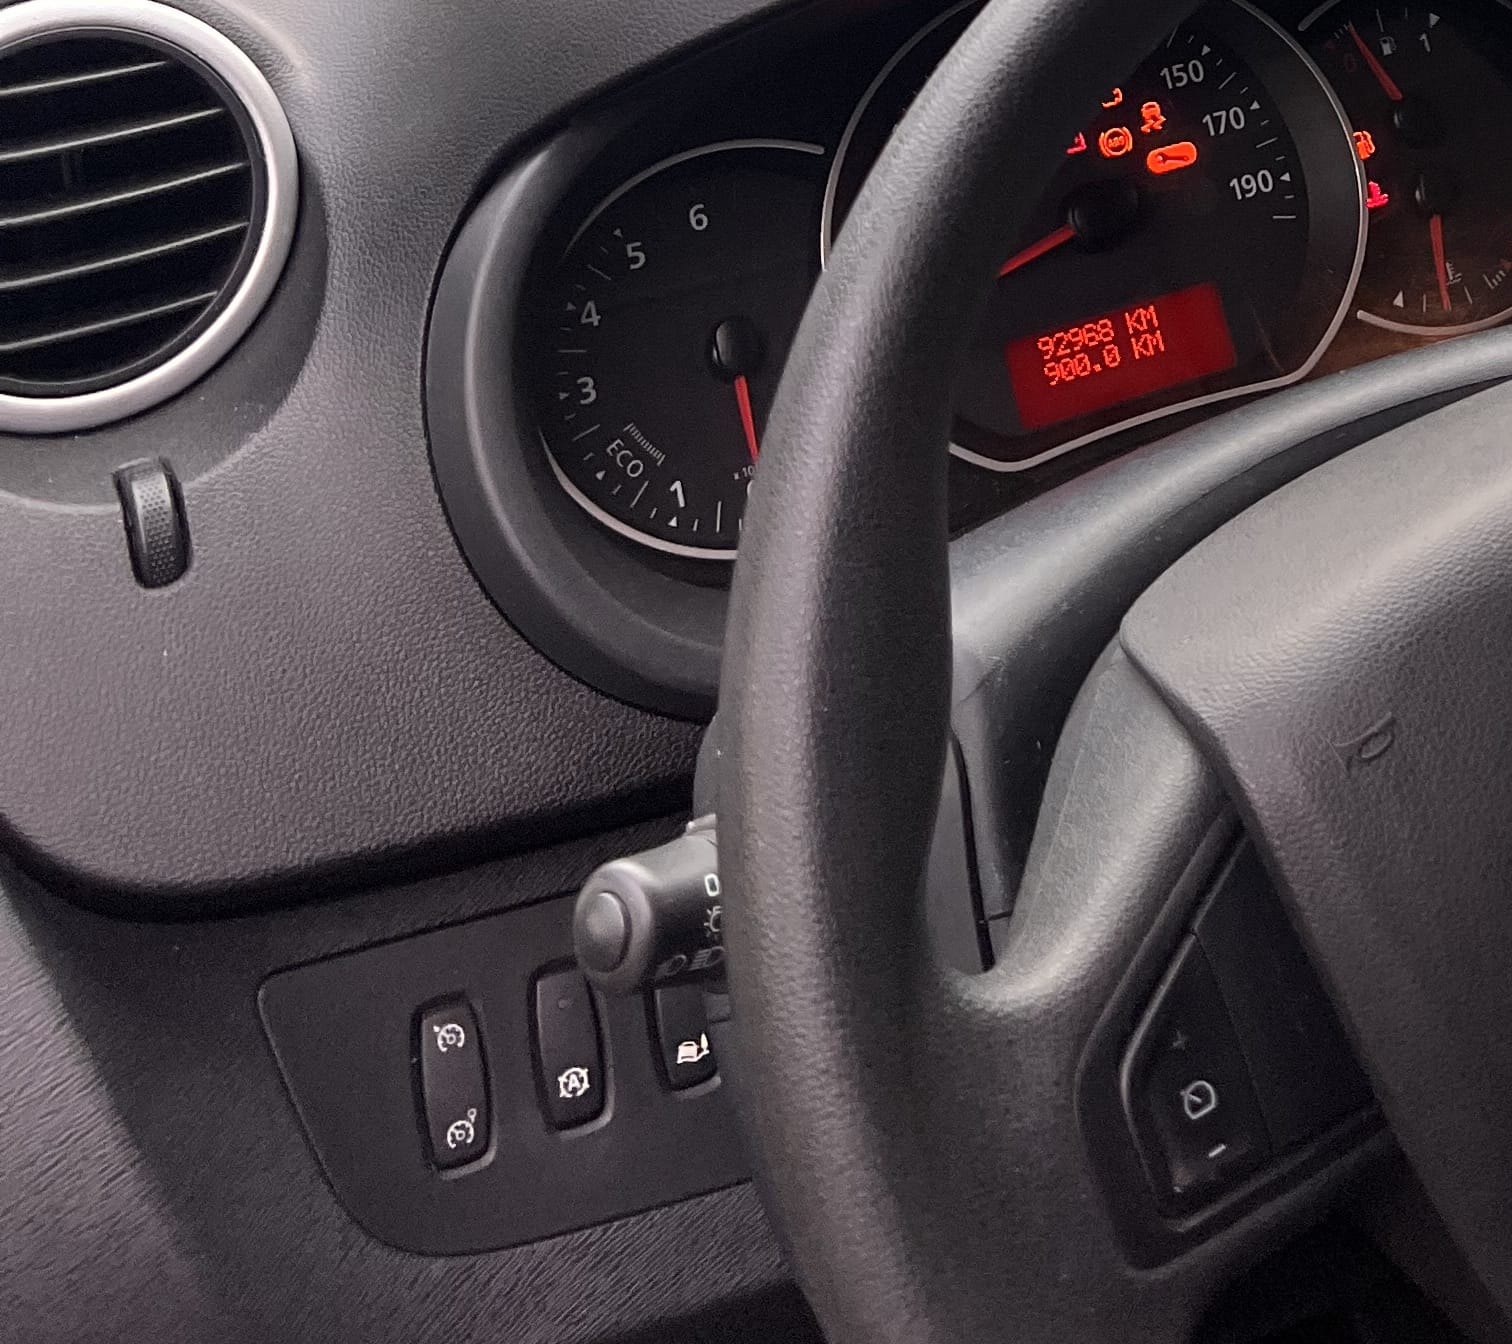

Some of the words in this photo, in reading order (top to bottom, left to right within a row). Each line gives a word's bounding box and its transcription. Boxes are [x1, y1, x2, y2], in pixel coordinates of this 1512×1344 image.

[1159, 59, 1205, 90] 150
[1202, 106, 1246, 137] 170
[1107, 135, 1126, 149] ABS
[1229, 169, 1274, 201] 190
[688, 203, 709, 231] 6
[625, 241, 646, 270] 5
[580, 300, 602, 327] 4
[1037, 319, 1115, 360] 92968
[1125, 305, 1159, 335] KM
[1044, 344, 1122, 386] 900.0
[1131, 330, 1166, 360] KM
[576, 376, 597, 404] 3
[606, 438, 644, 478] ECO
[669, 480, 686, 508] 1
